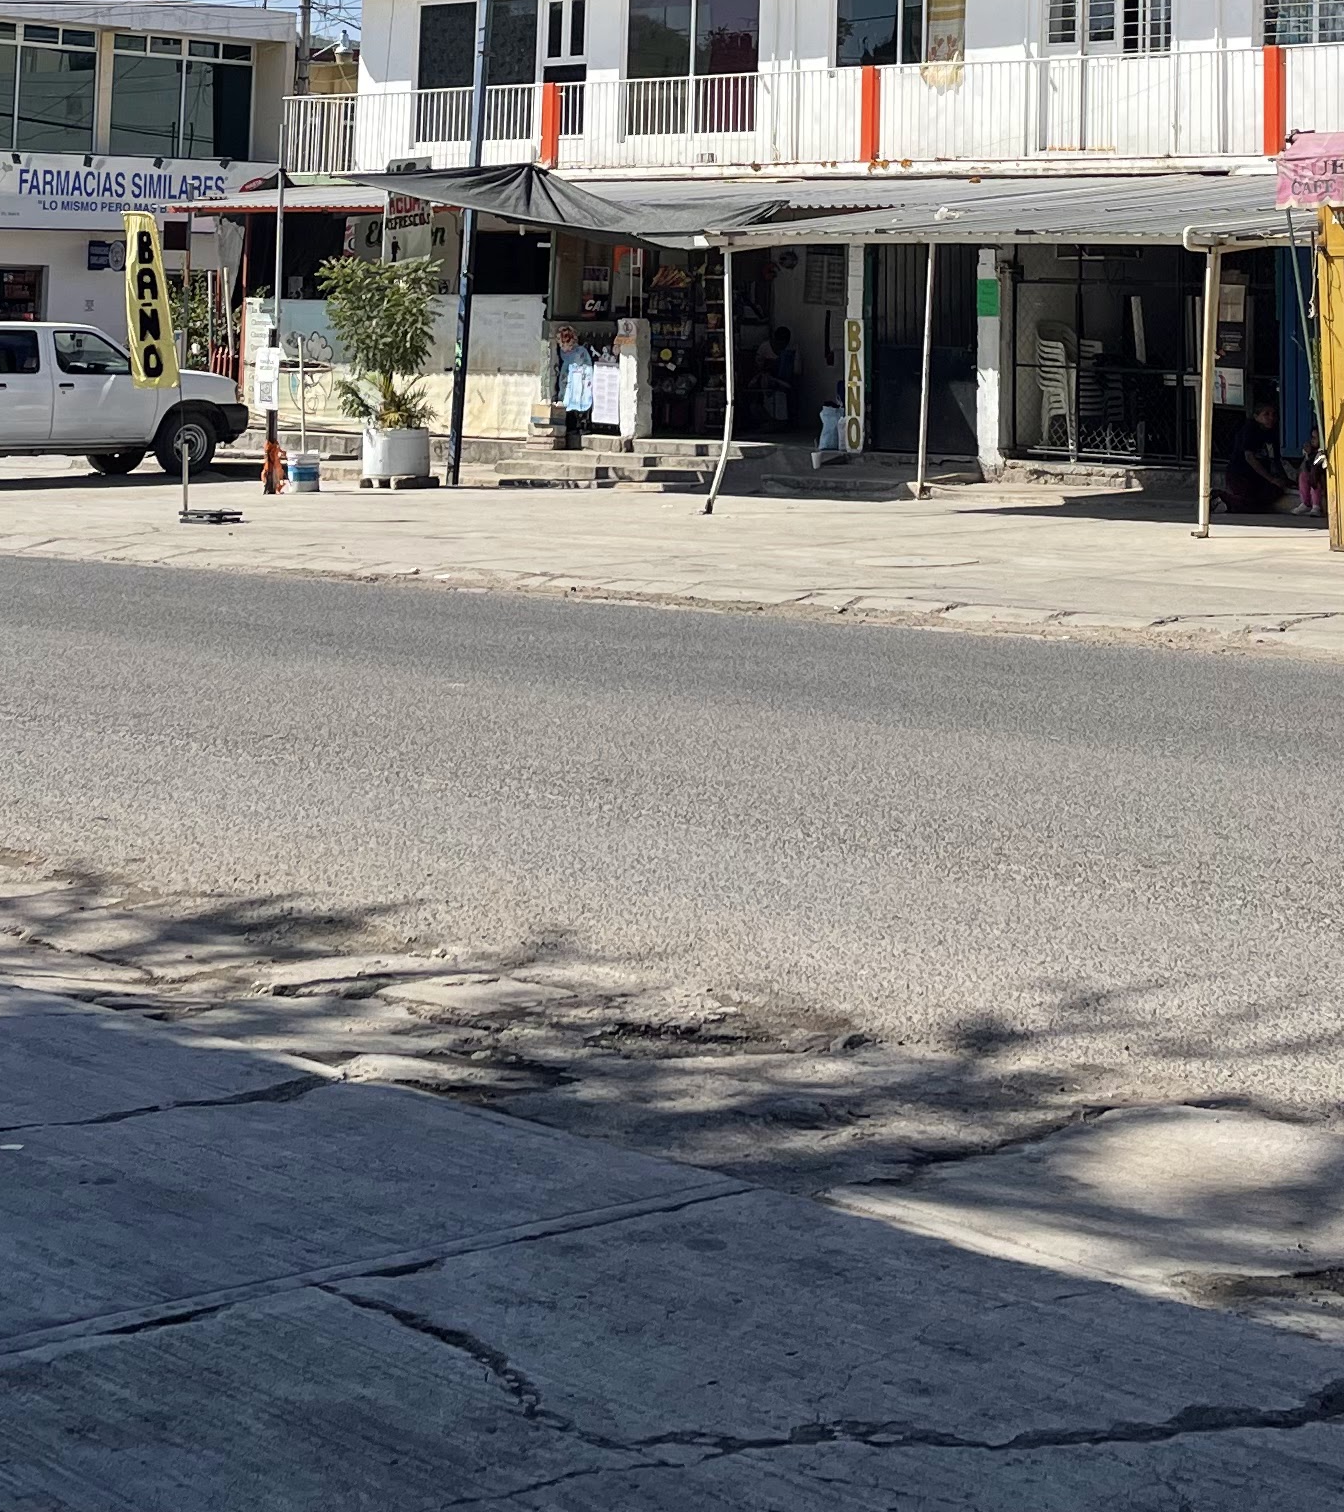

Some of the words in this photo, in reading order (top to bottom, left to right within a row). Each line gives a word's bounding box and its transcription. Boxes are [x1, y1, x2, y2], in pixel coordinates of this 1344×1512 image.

[19, 168, 126, 198] FARMACIAS
[132, 172, 225, 199] SIMILARES
[61, 201, 97, 212] MISMO
[101, 202, 130, 213] PERO
[137, 231, 163, 378] BAÑO
[847, 320, 862, 450] BAÑO
